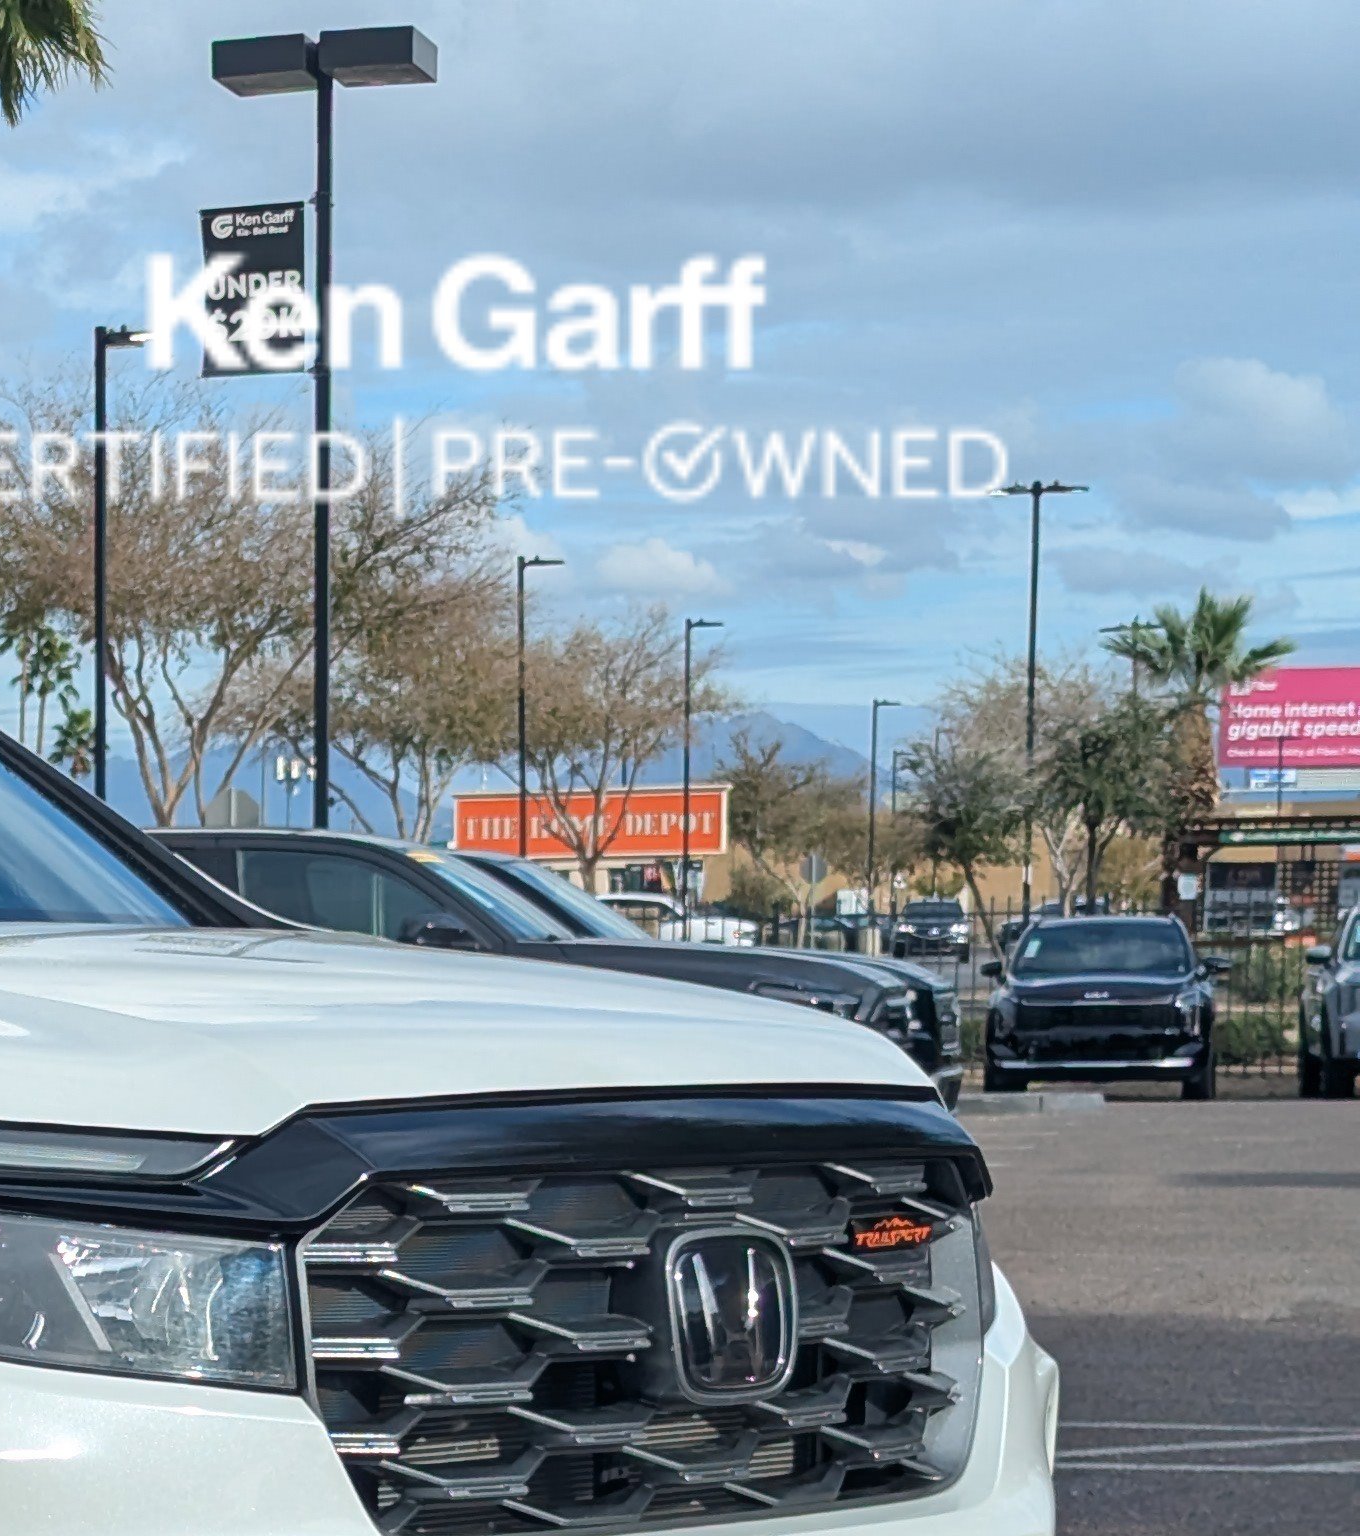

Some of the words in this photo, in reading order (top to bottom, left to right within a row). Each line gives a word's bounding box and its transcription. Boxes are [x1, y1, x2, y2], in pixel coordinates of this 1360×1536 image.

[235, 212, 261, 227] Ken
[262, 209, 295, 224] Garff
[208, 270, 301, 300] UNDER
[1284, 701, 1355, 717] internet
[1228, 721, 1301, 741] gigabit
[463, 817, 518, 841] THE
[625, 811, 713, 836] DEPOT
